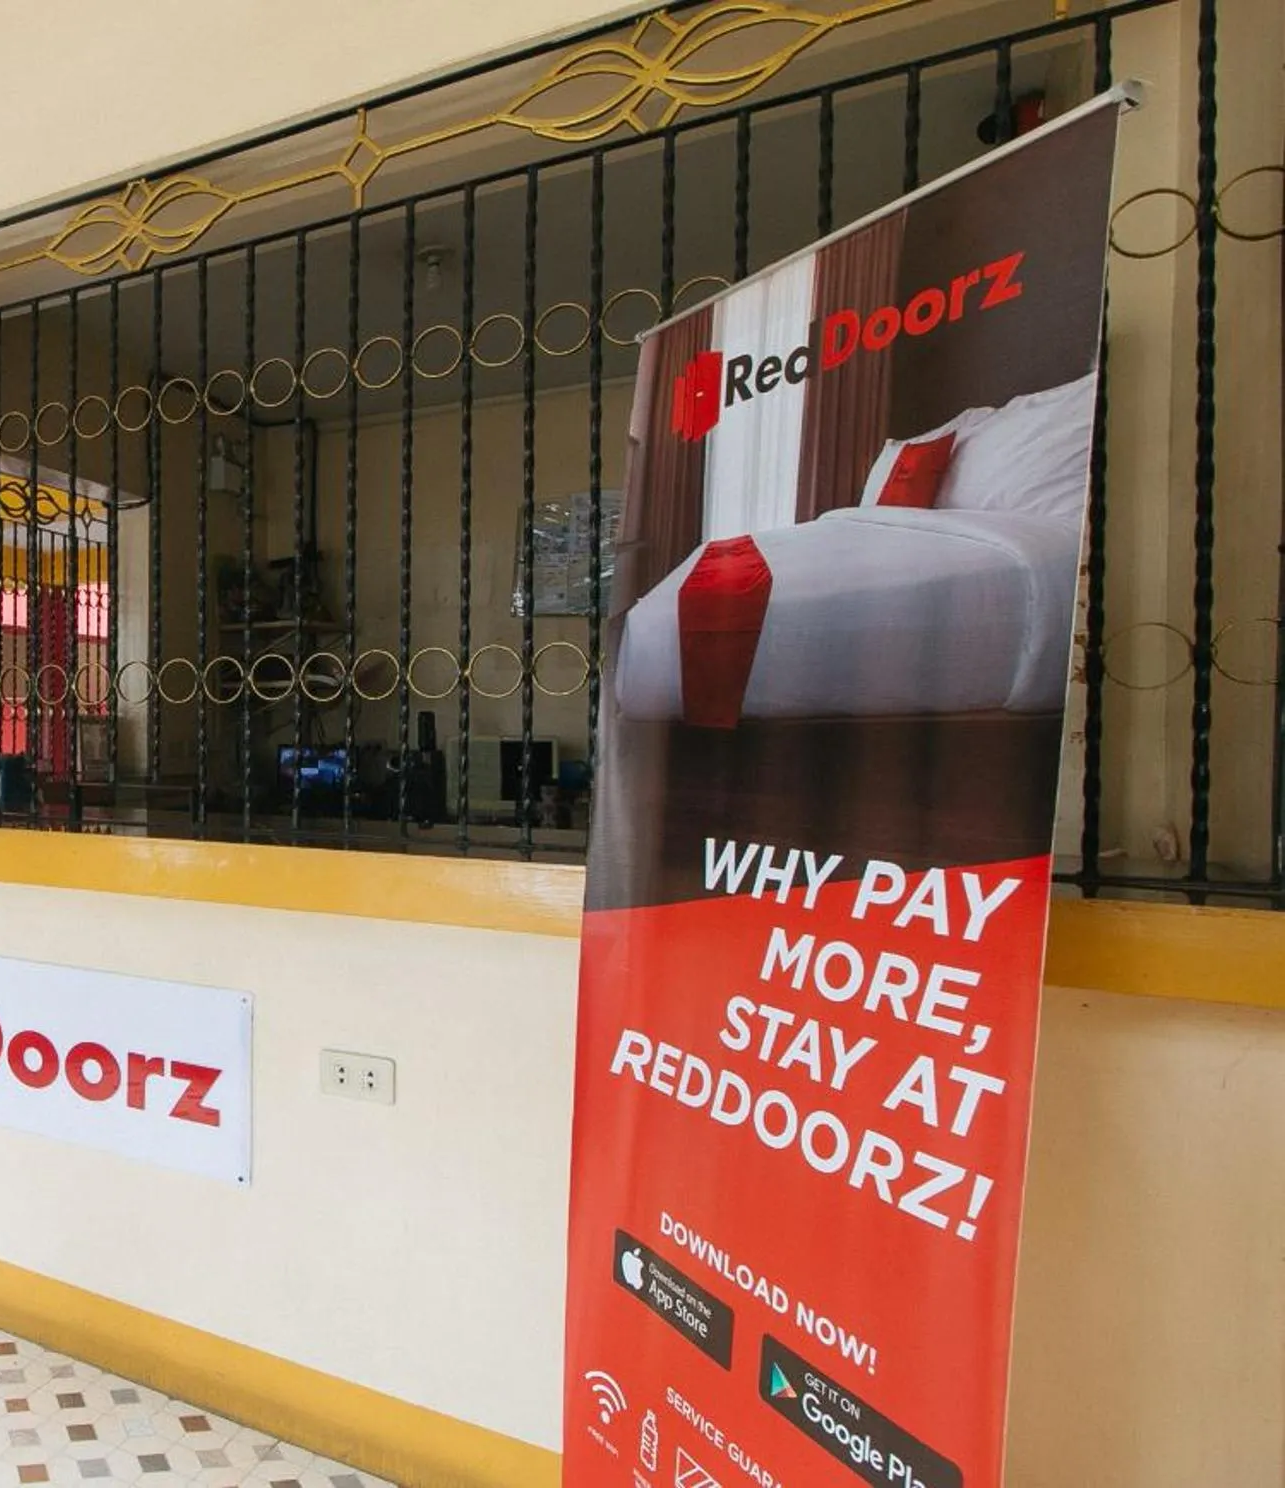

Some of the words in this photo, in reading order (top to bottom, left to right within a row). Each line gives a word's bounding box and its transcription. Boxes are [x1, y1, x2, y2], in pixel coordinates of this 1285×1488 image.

[704, 837, 844, 910] WHY
[851, 859, 1022, 942] PAY
[760, 927, 991, 1055] MORE,
[719, 995, 878, 1091] STAY
[883, 1056, 1006, 1138] AT
[609, 1029, 994, 1242] REDDOORZ!
[649, 1262, 686, 1298] Download
[649, 1279, 673, 1310] App
[674, 1299, 708, 1338] Store
[660, 1212, 789, 1315] DOWNLOAD
[796, 1301, 878, 1375] NOW!
[666, 1386, 724, 1449] SERVICE
[727, 1443, 784, 1488] GUAR
[801, 1392, 884, 1471] Google
[804, 1372, 827, 1396] GET
[828, 1389, 839, 1404] IT
[840, 1398, 861, 1420] ON
